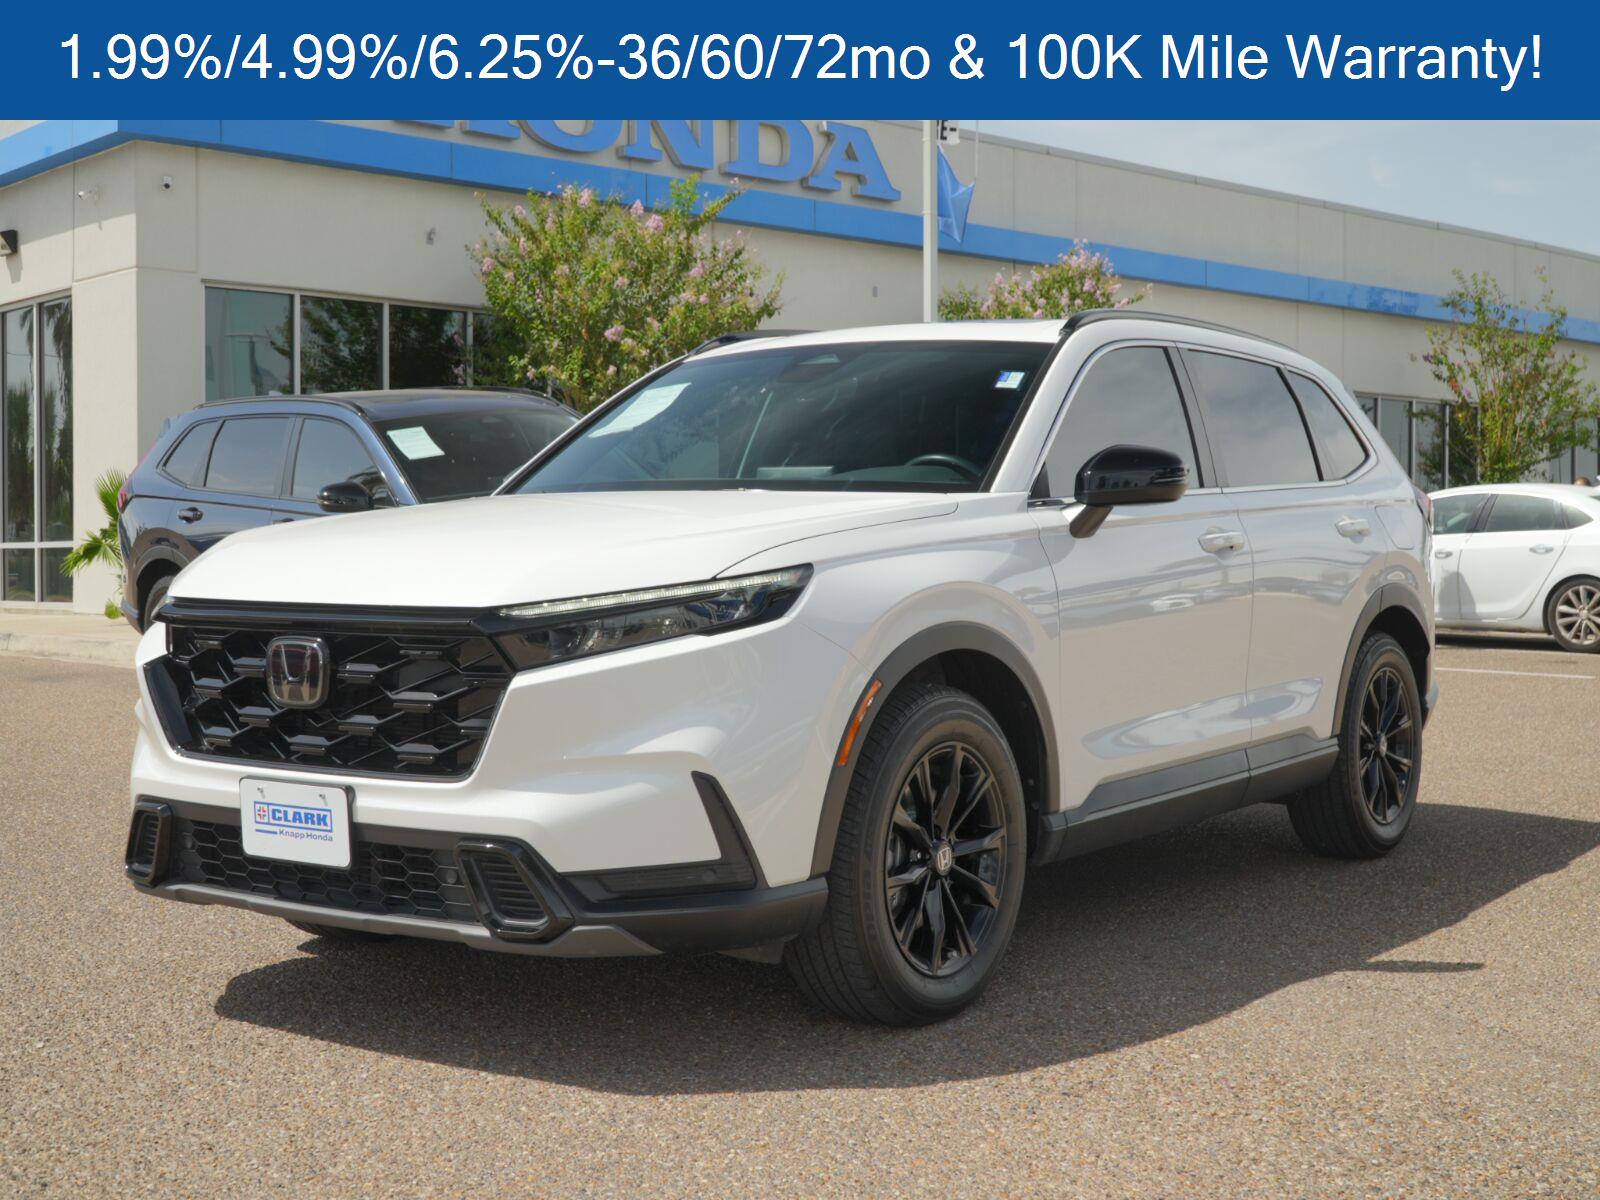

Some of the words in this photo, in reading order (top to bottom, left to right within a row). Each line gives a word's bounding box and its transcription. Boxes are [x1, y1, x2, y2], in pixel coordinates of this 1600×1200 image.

[271, 808, 329, 827] CLARK
[278, 828, 305, 839] Knapp
[305, 832, 333, 842] Honda
